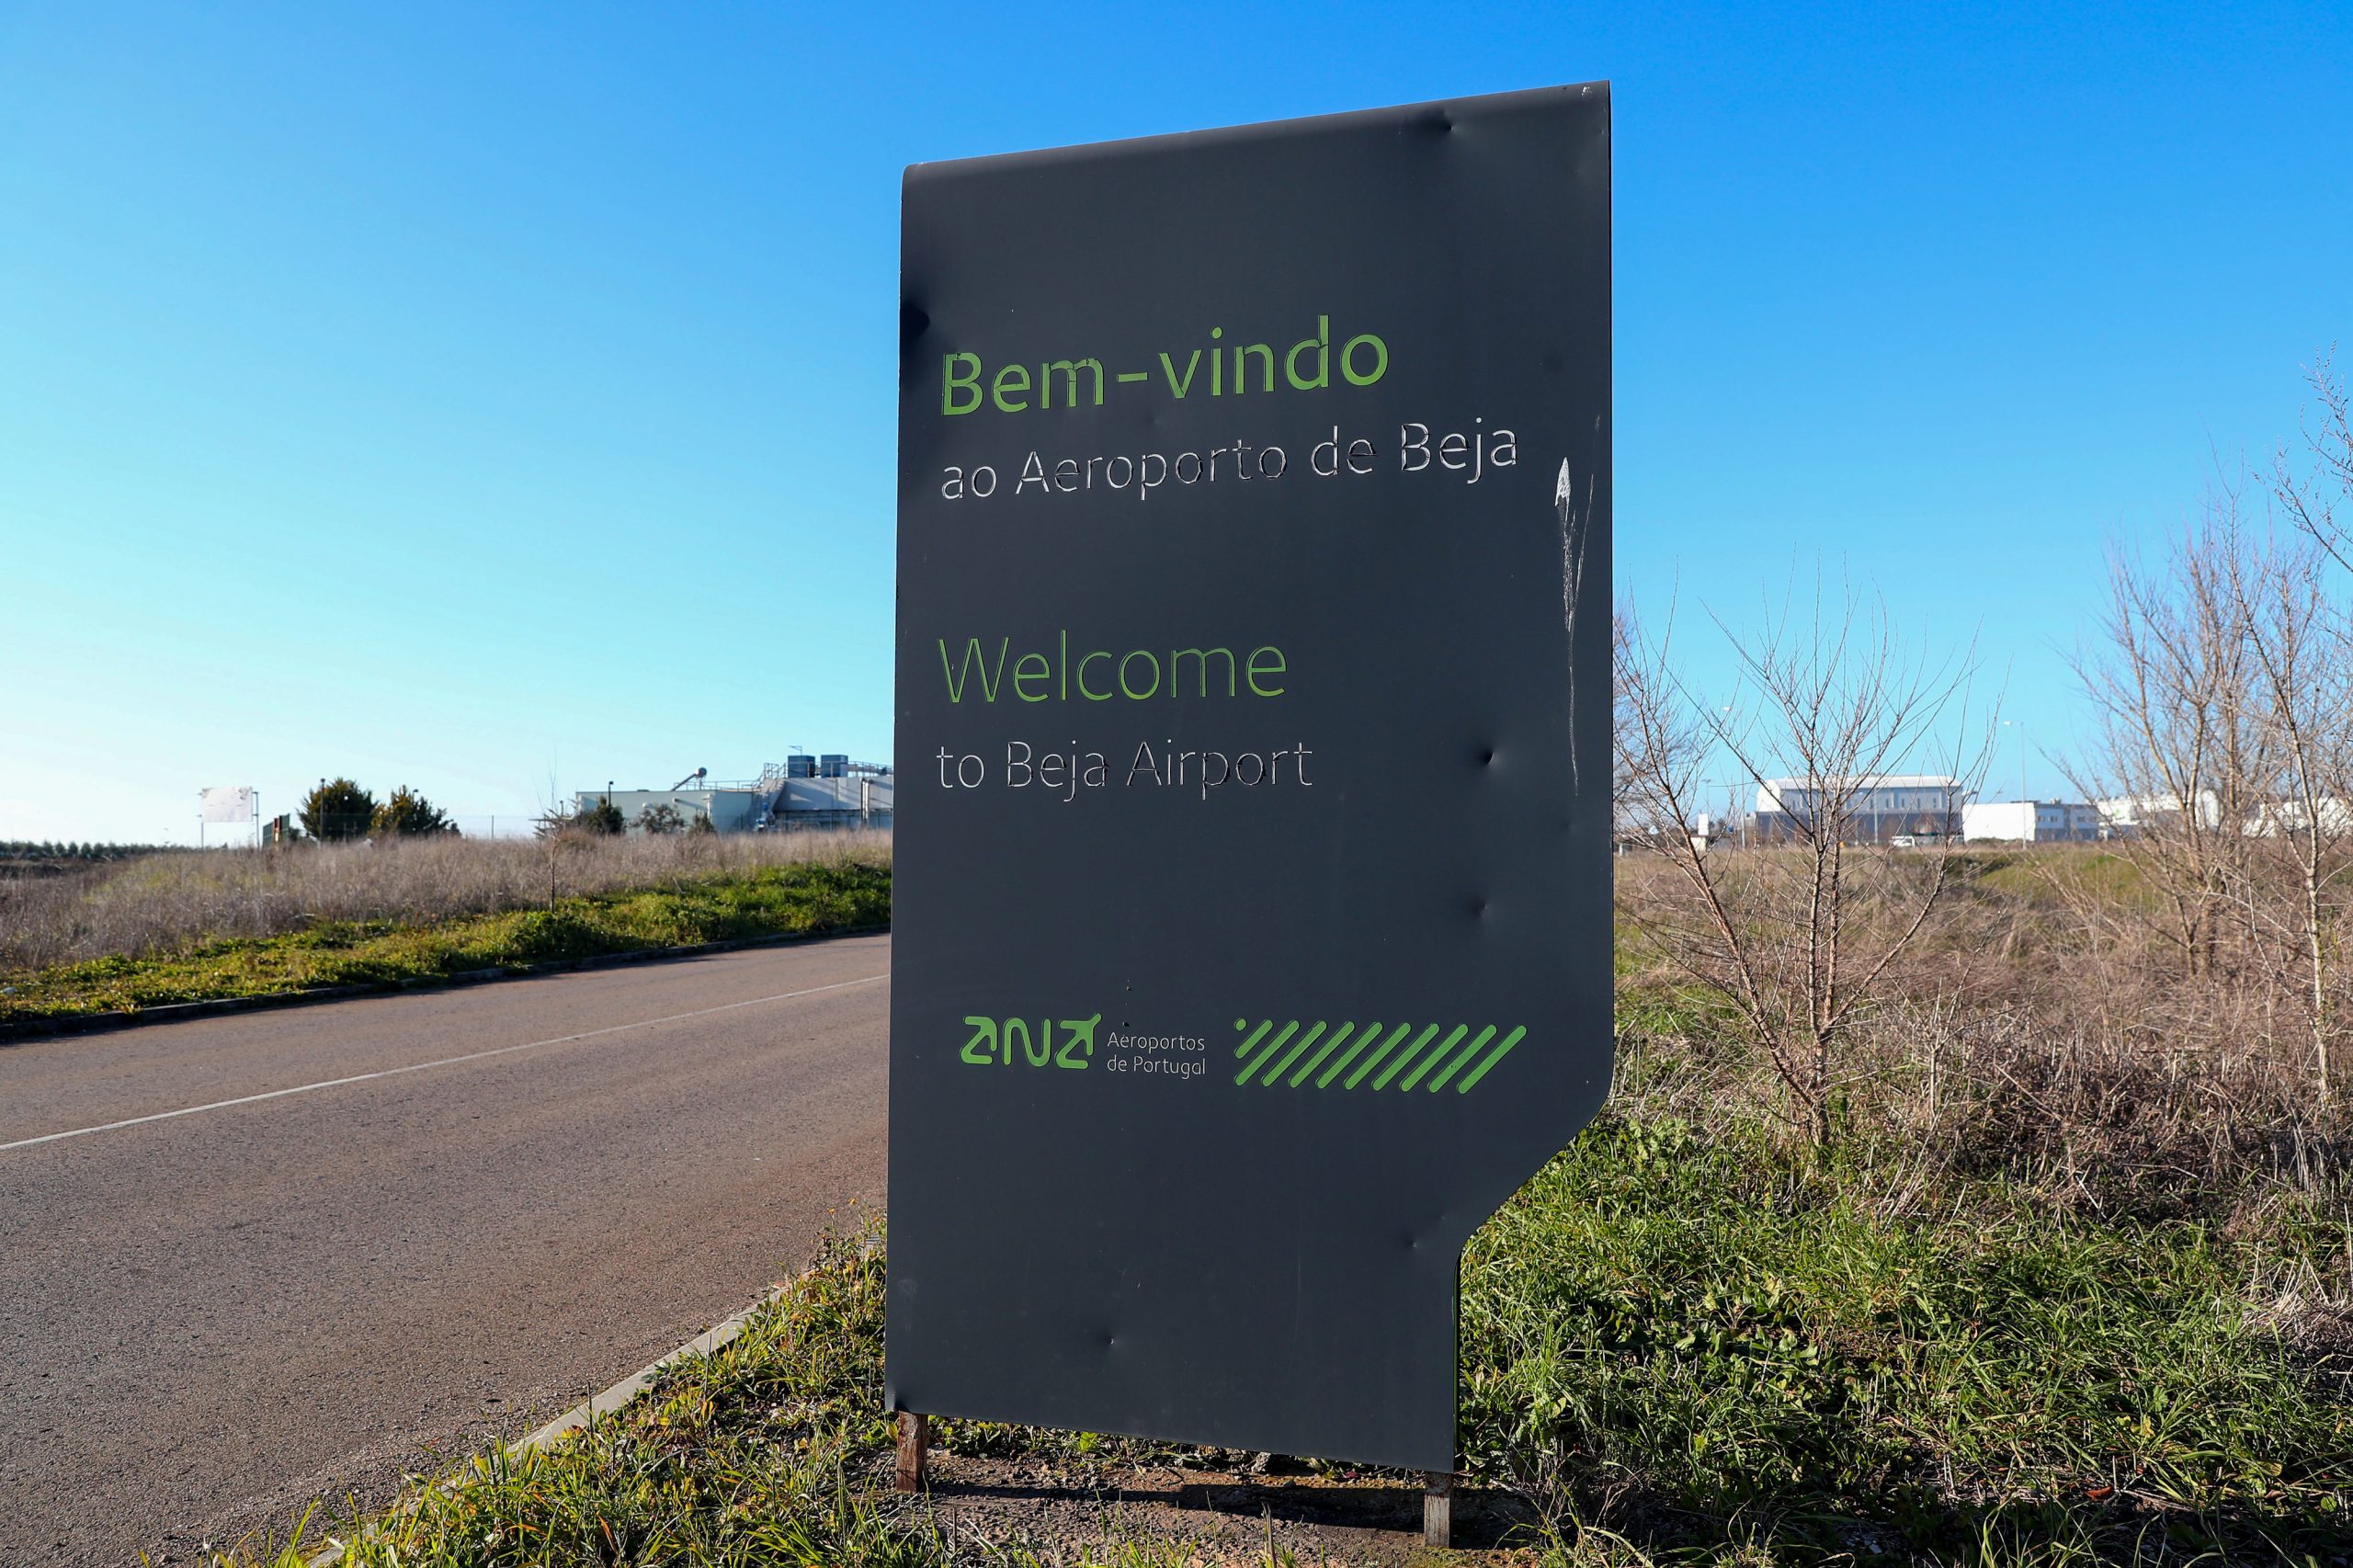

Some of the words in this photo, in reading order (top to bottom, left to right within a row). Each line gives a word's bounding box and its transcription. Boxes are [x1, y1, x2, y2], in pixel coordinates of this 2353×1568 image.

[941, 314, 1390, 416] Bem-vindo
[940, 462, 998, 501] ao
[1015, 438, 1288, 502] Aeroporto
[1310, 426, 1377, 476] de
[1400, 416, 1518, 484] Beja
[938, 630, 1289, 704] Welcome
[936, 745, 985, 789] to
[1006, 739, 1108, 802] Beja
[1126, 738, 1313, 801] Airport
[1107, 1031, 1206, 1053] Aeroportos
[1107, 1054, 1128, 1073] de
[1133, 1056, 1206, 1080] Portugal
